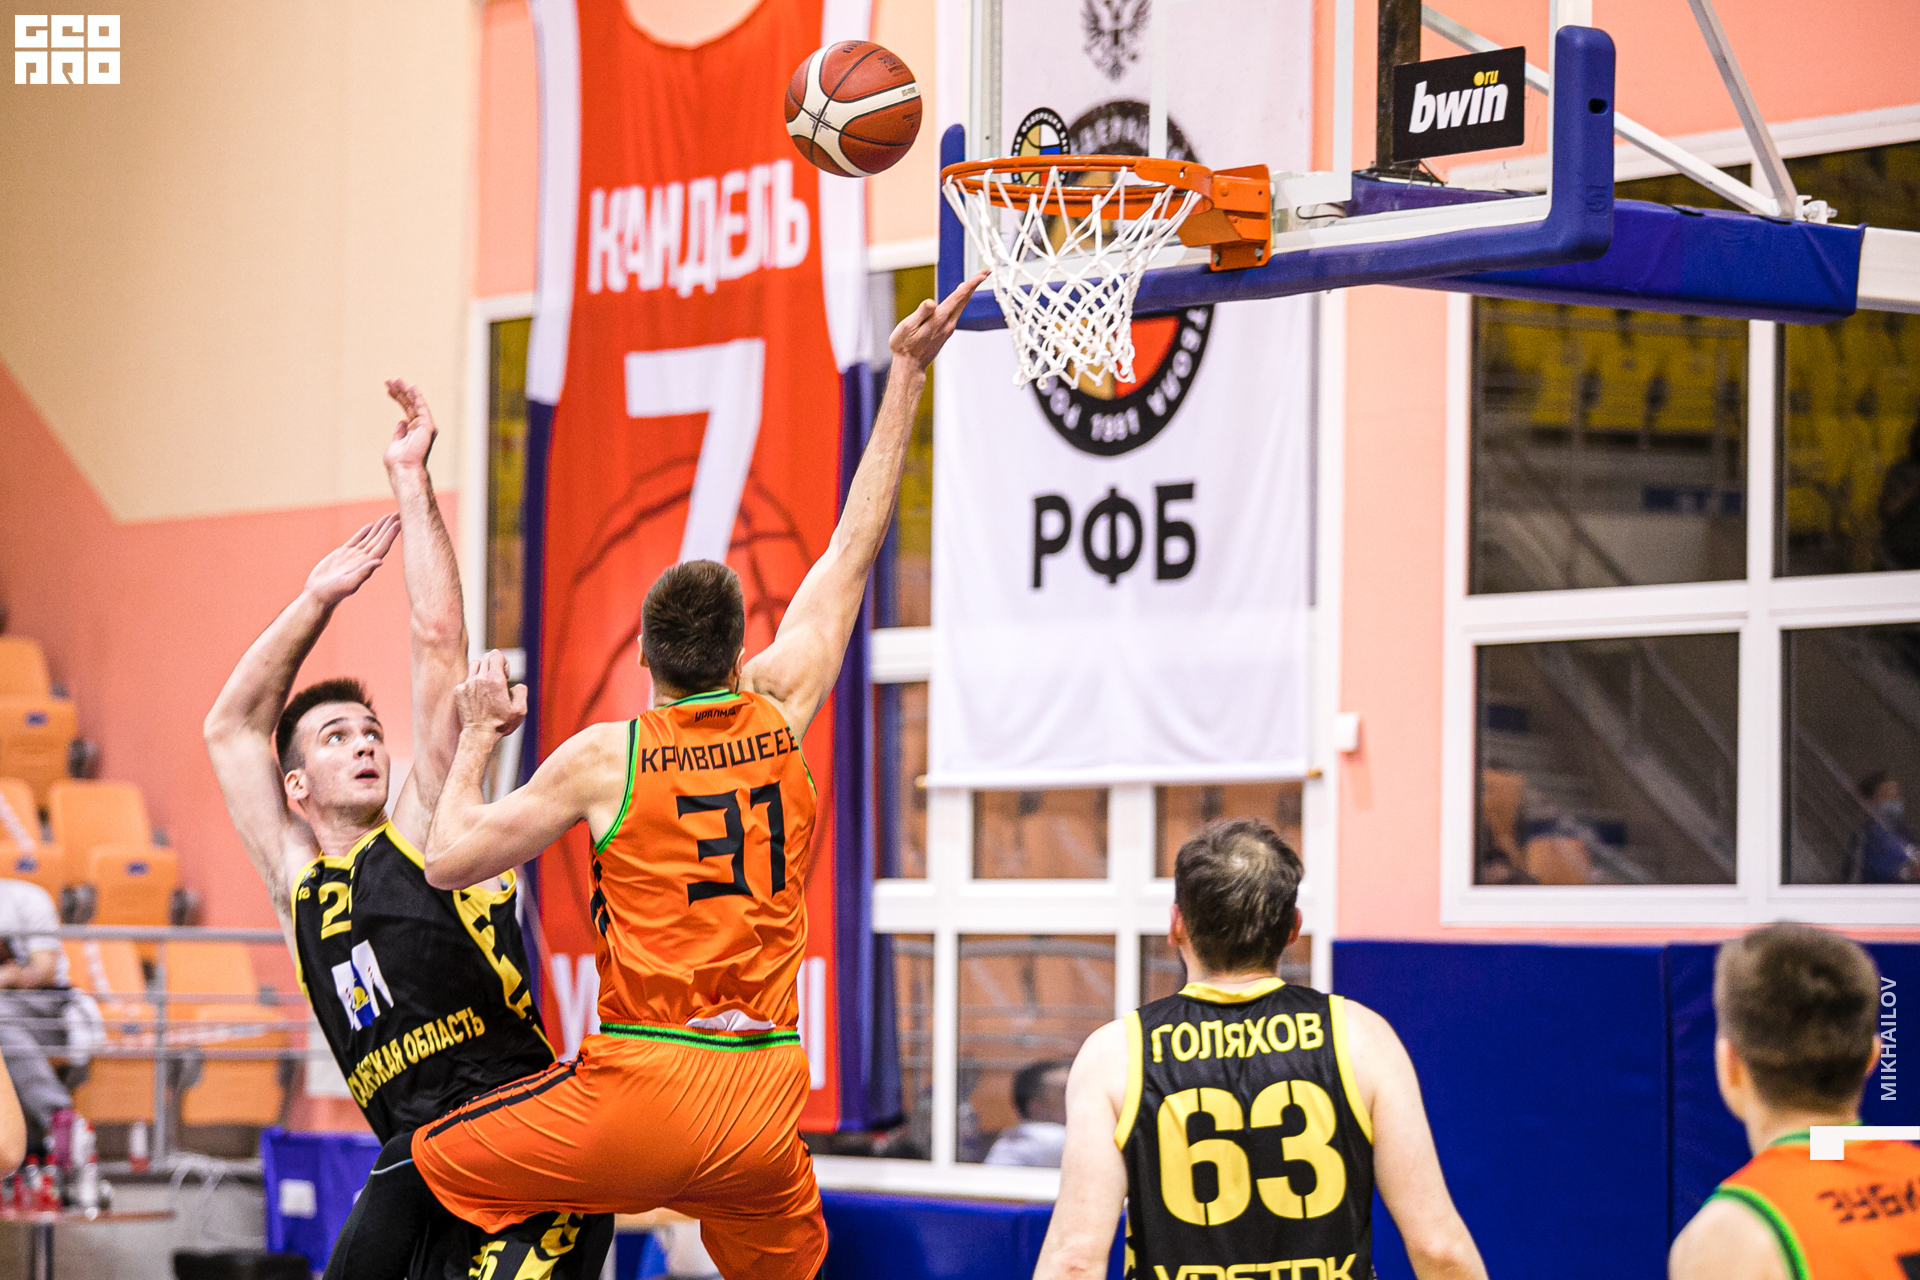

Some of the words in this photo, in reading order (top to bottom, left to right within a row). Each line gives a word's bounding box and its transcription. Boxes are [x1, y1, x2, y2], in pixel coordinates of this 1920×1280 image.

[1409, 81, 1508, 133] bwin
[588, 158, 810, 298] КАНДЕЛЬ
[624, 337, 766, 563] 7
[1031, 482, 1198, 589] РФБ
[675, 780, 786, 907] 31
[403, 1007, 485, 1064] ОБЛАСТЬ
[1151, 1013, 1324, 1063] ГОЛЯХОВ
[1157, 1080, 1347, 1226] 63
